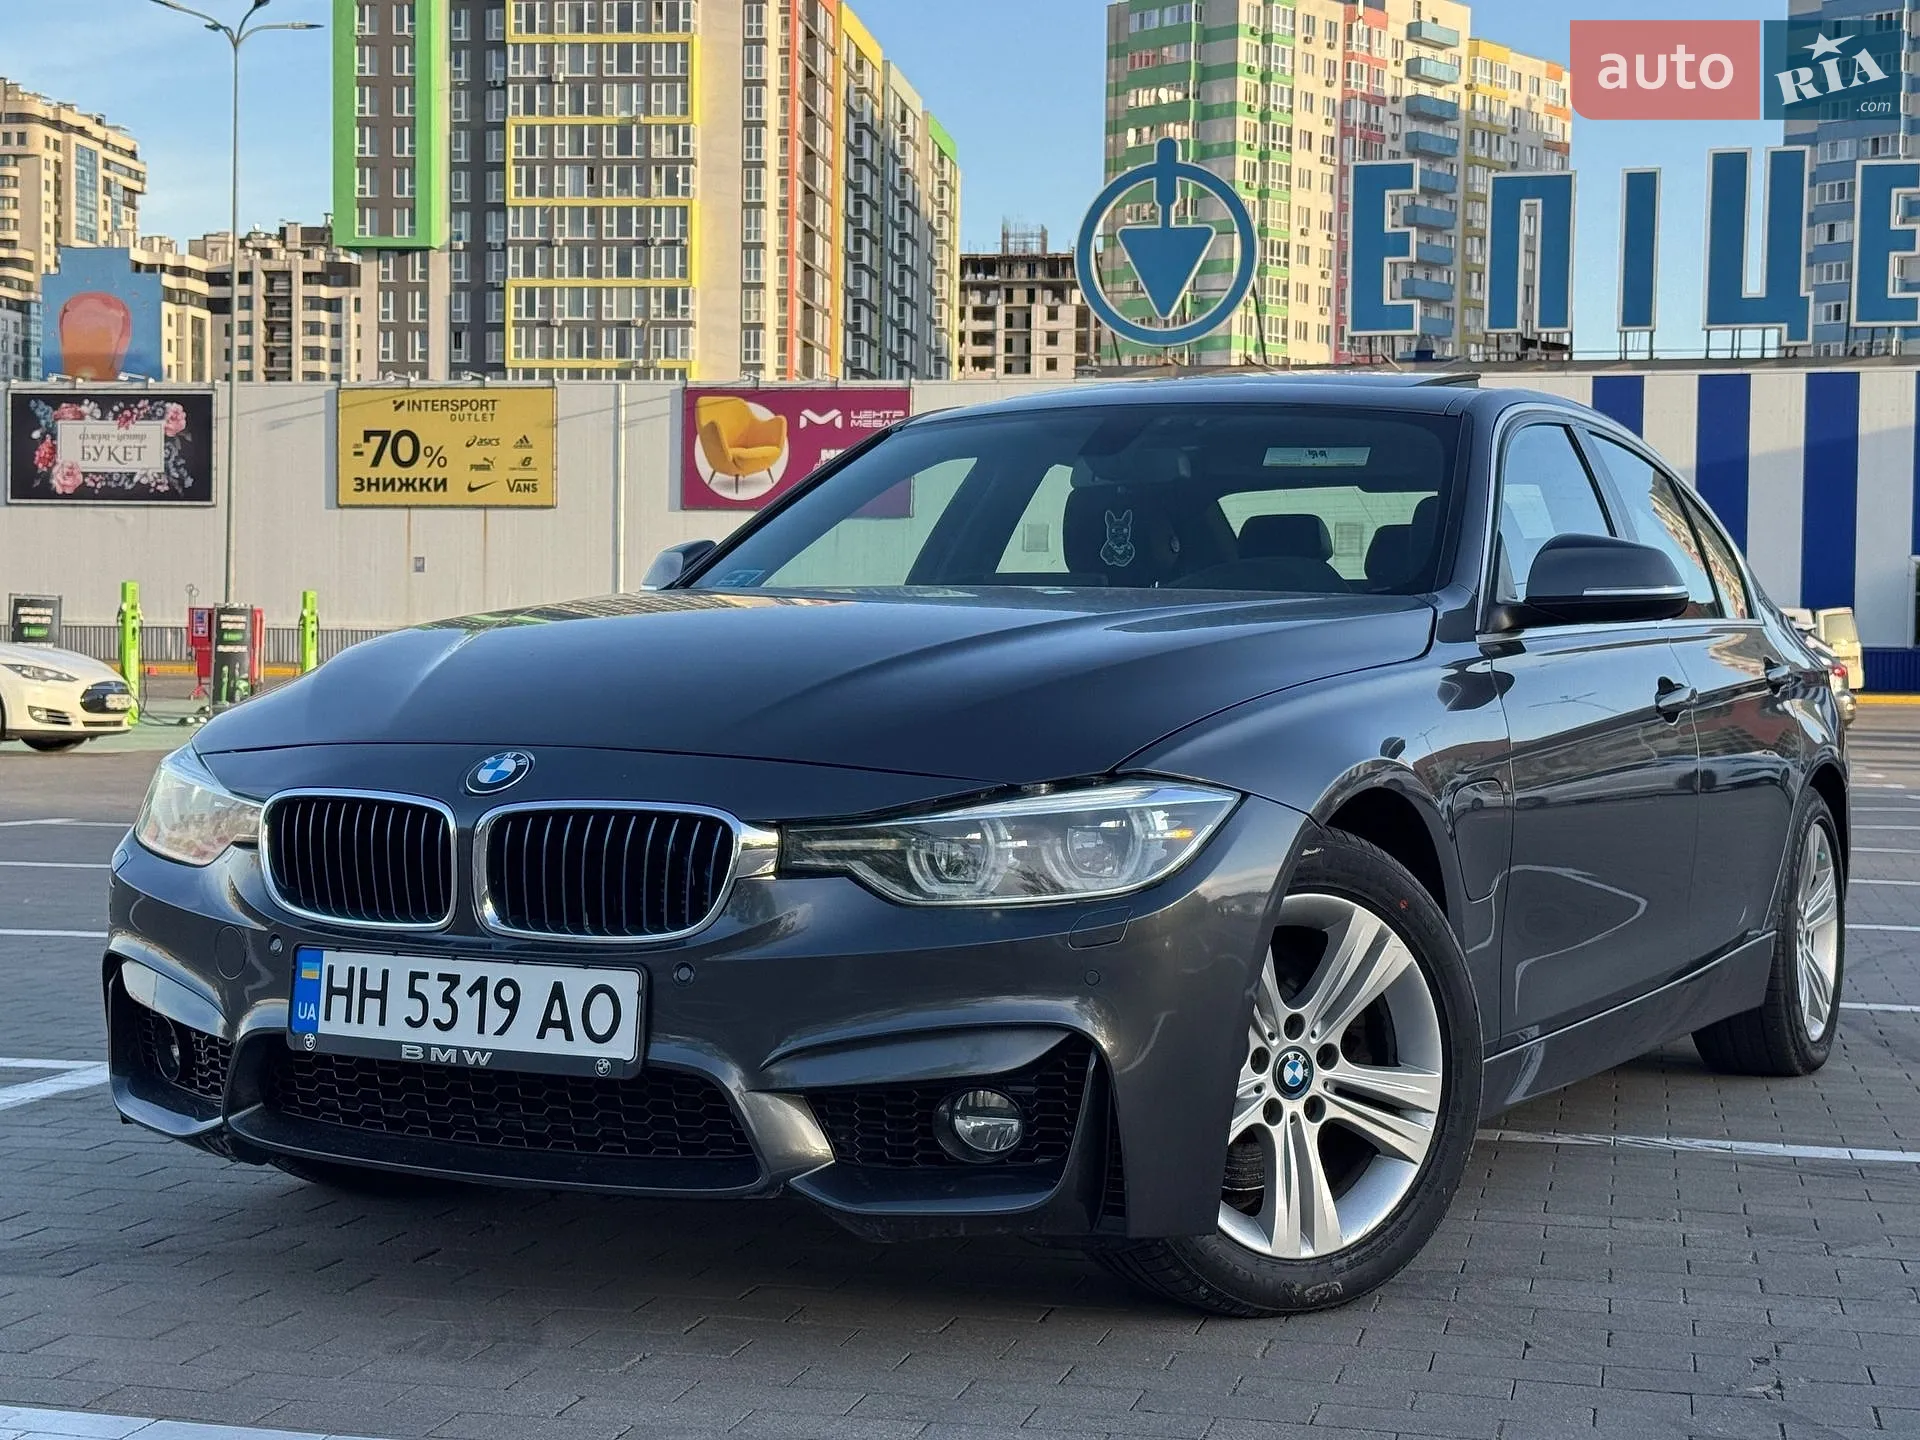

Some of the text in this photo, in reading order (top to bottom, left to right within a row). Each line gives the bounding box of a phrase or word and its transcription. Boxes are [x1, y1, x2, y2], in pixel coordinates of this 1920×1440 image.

[406, 399, 499, 412] INTERSPORT
[450, 413, 496, 423] OUTLET
[850, 410, 905, 419] ЦЕНТР
[81, 445, 147, 466] БУКЕТ
[353, 429, 448, 469] -70%
[353, 477, 448, 493] ЗНИЖКИ
[506, 478, 539, 493] VANS
[298, 1002, 317, 1021] UA
[324, 964, 622, 1045] HH 5319 AO
[401, 1044, 493, 1067] BMW
